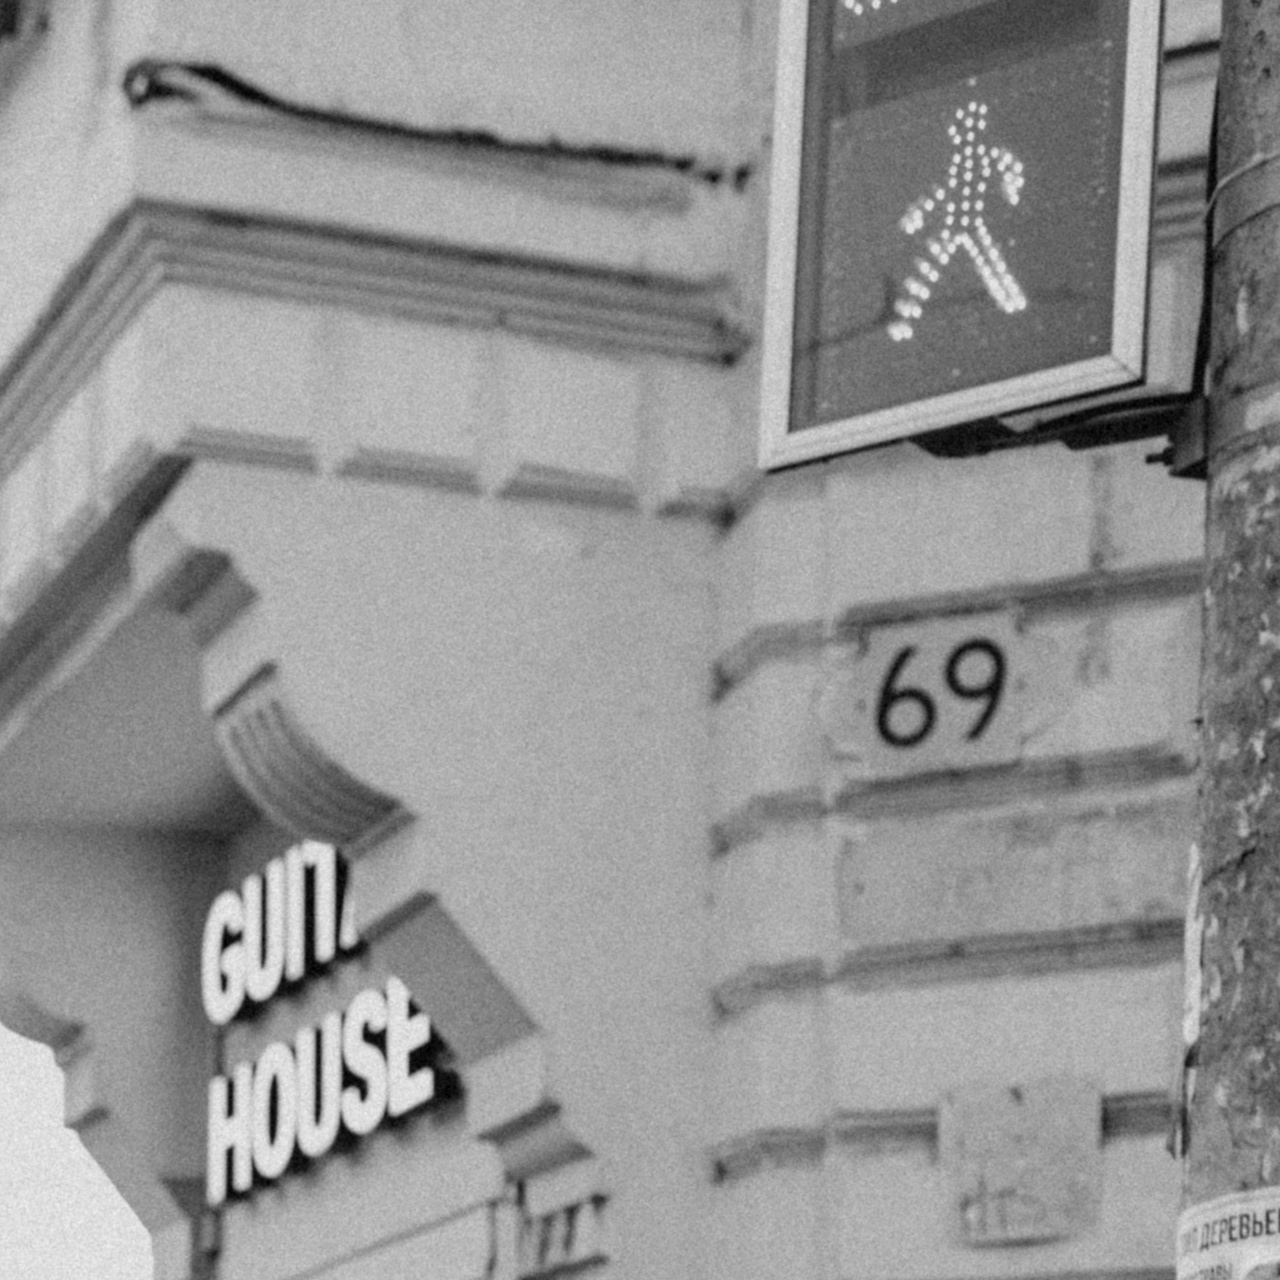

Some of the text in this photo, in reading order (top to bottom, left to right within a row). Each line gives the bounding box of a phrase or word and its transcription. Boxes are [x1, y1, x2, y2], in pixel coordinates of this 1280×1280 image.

[875, 638, 1007, 748] 69
[206, 975, 435, 1207] HOUSE
[1200, 1207, 1280, 1253] ДЕРЕВЬЕ
